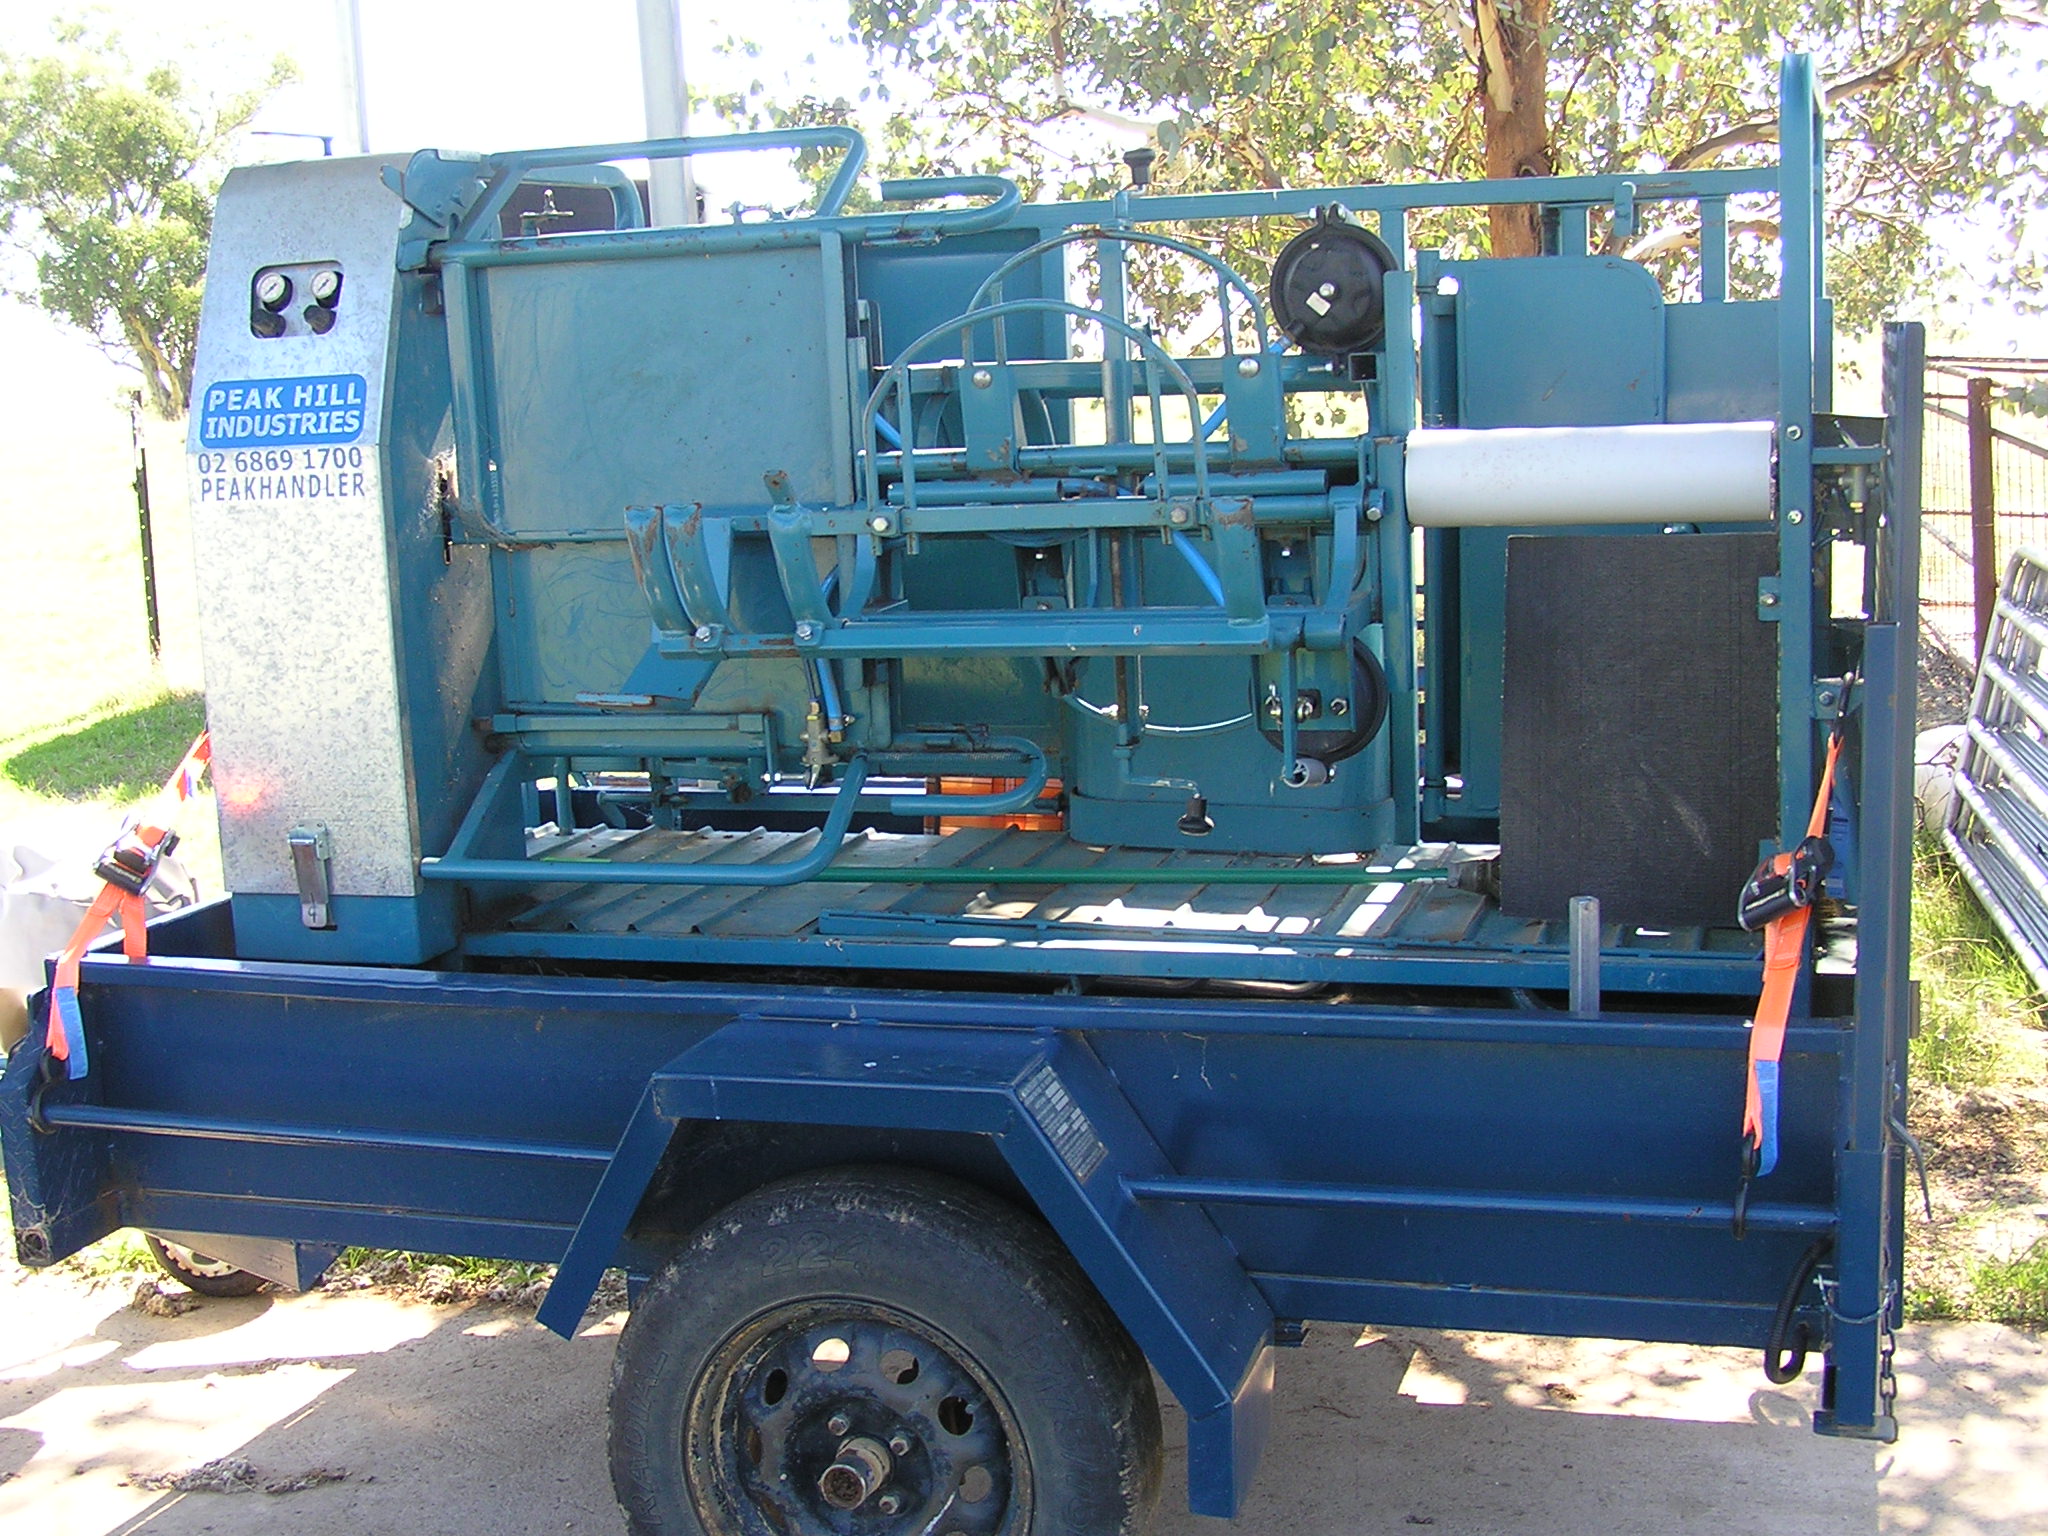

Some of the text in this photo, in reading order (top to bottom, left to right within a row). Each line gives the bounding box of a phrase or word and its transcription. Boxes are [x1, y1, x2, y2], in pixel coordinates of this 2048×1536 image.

[208, 382, 361, 413] PEAK HILL
[205, 409, 361, 440] INDUSTRIES
[198, 446, 363, 475] 02 6869 1700
[201, 472, 366, 502] PEAKHANDLER
[623, 1351, 670, 1527] RADIAL
